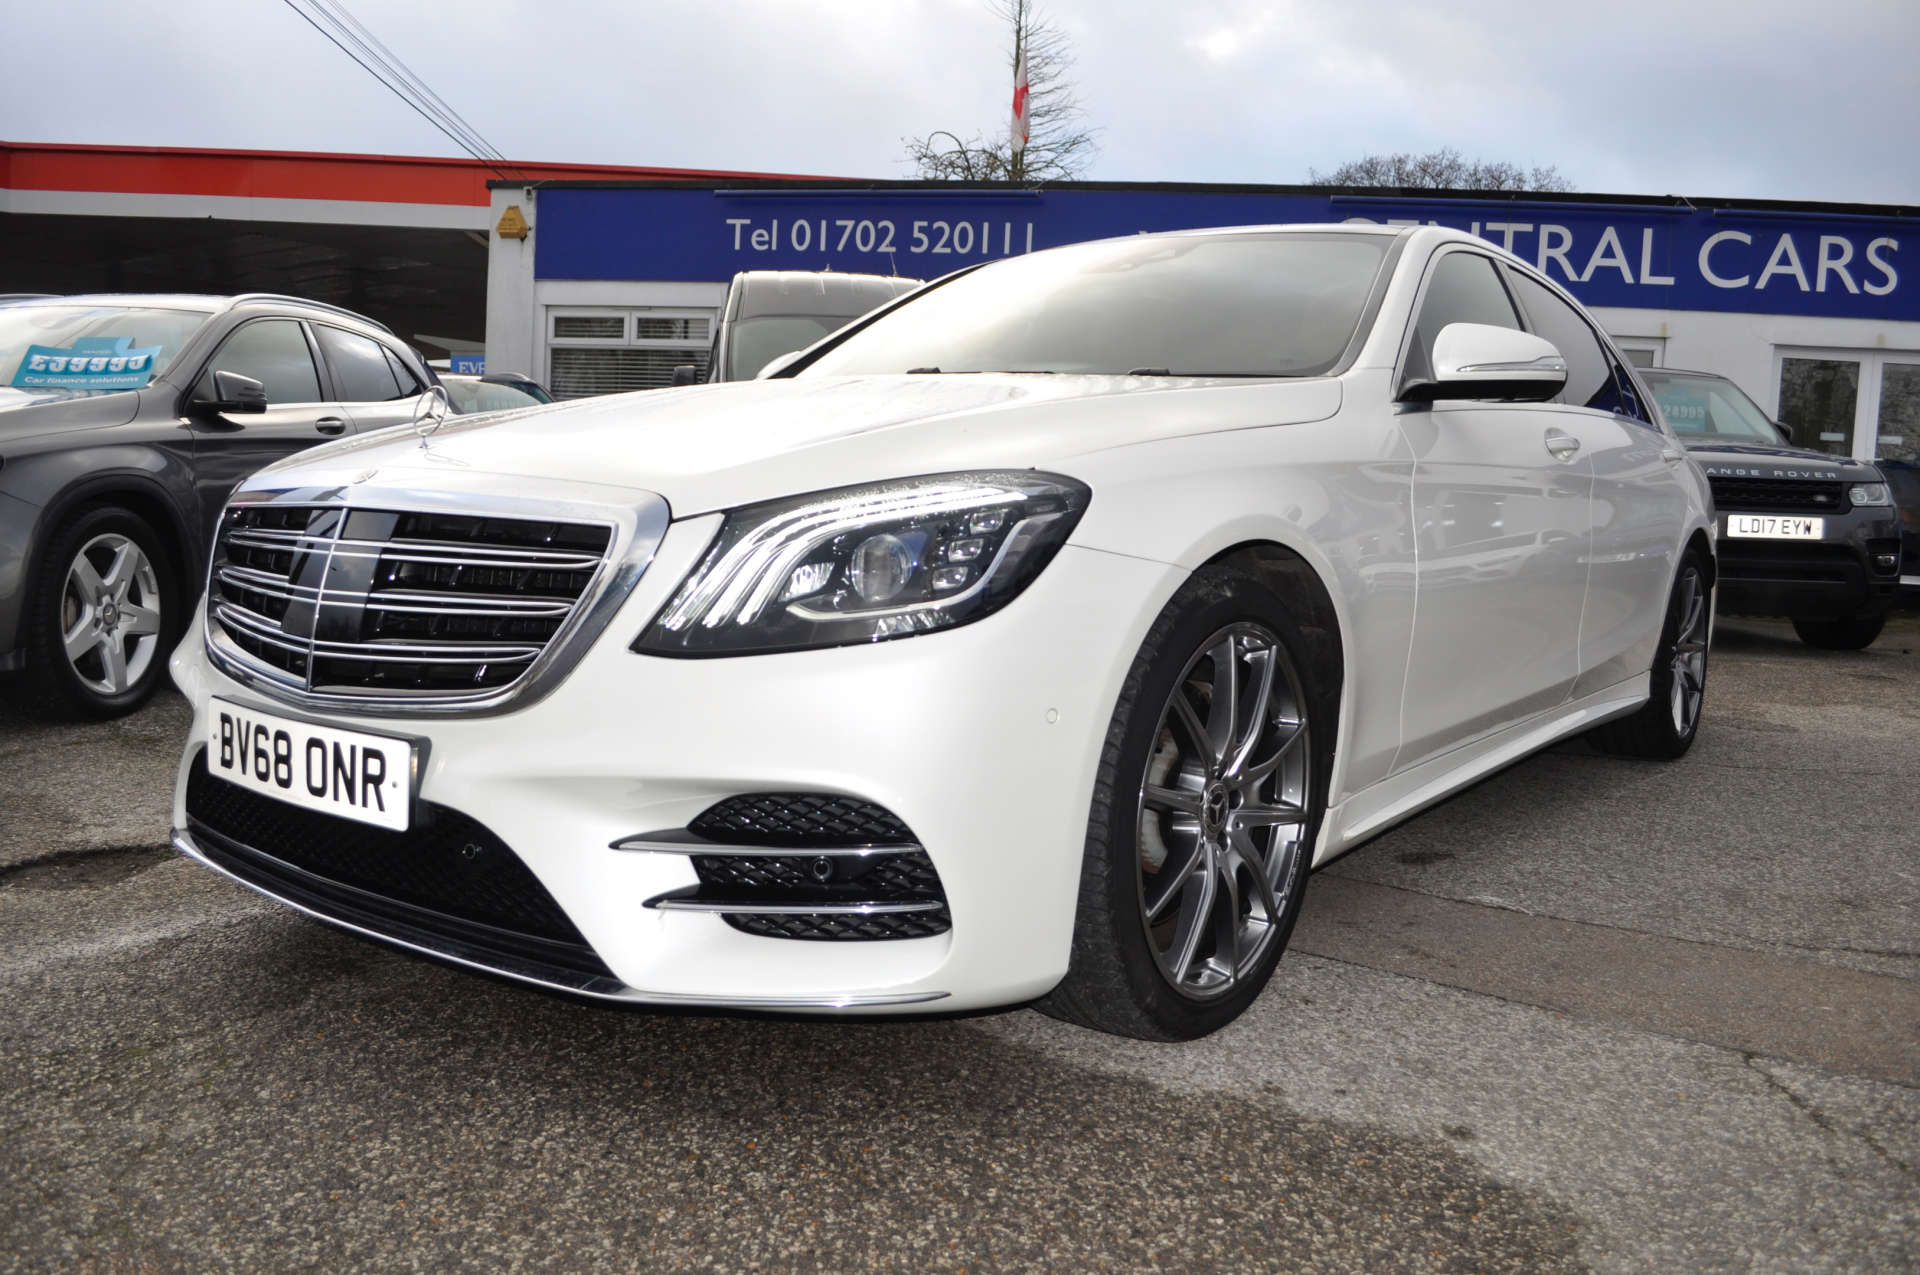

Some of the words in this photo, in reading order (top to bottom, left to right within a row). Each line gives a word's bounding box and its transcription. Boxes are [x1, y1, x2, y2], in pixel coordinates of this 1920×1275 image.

[726, 218, 778, 251] Tel
[791, 219, 896, 252] 01702
[910, 220, 1033, 254] 520111
[1340, 217, 1675, 285] TRAL
[1699, 230, 1898, 296] CARS
[1706, 467, 1760, 476] ANGE
[1773, 470, 1836, 478] ROVER
[1739, 517, 1776, 533] LD17
[1781, 519, 1812, 535] EYW
[220, 712, 293, 789] BV68
[306, 736, 386, 812] ONR
